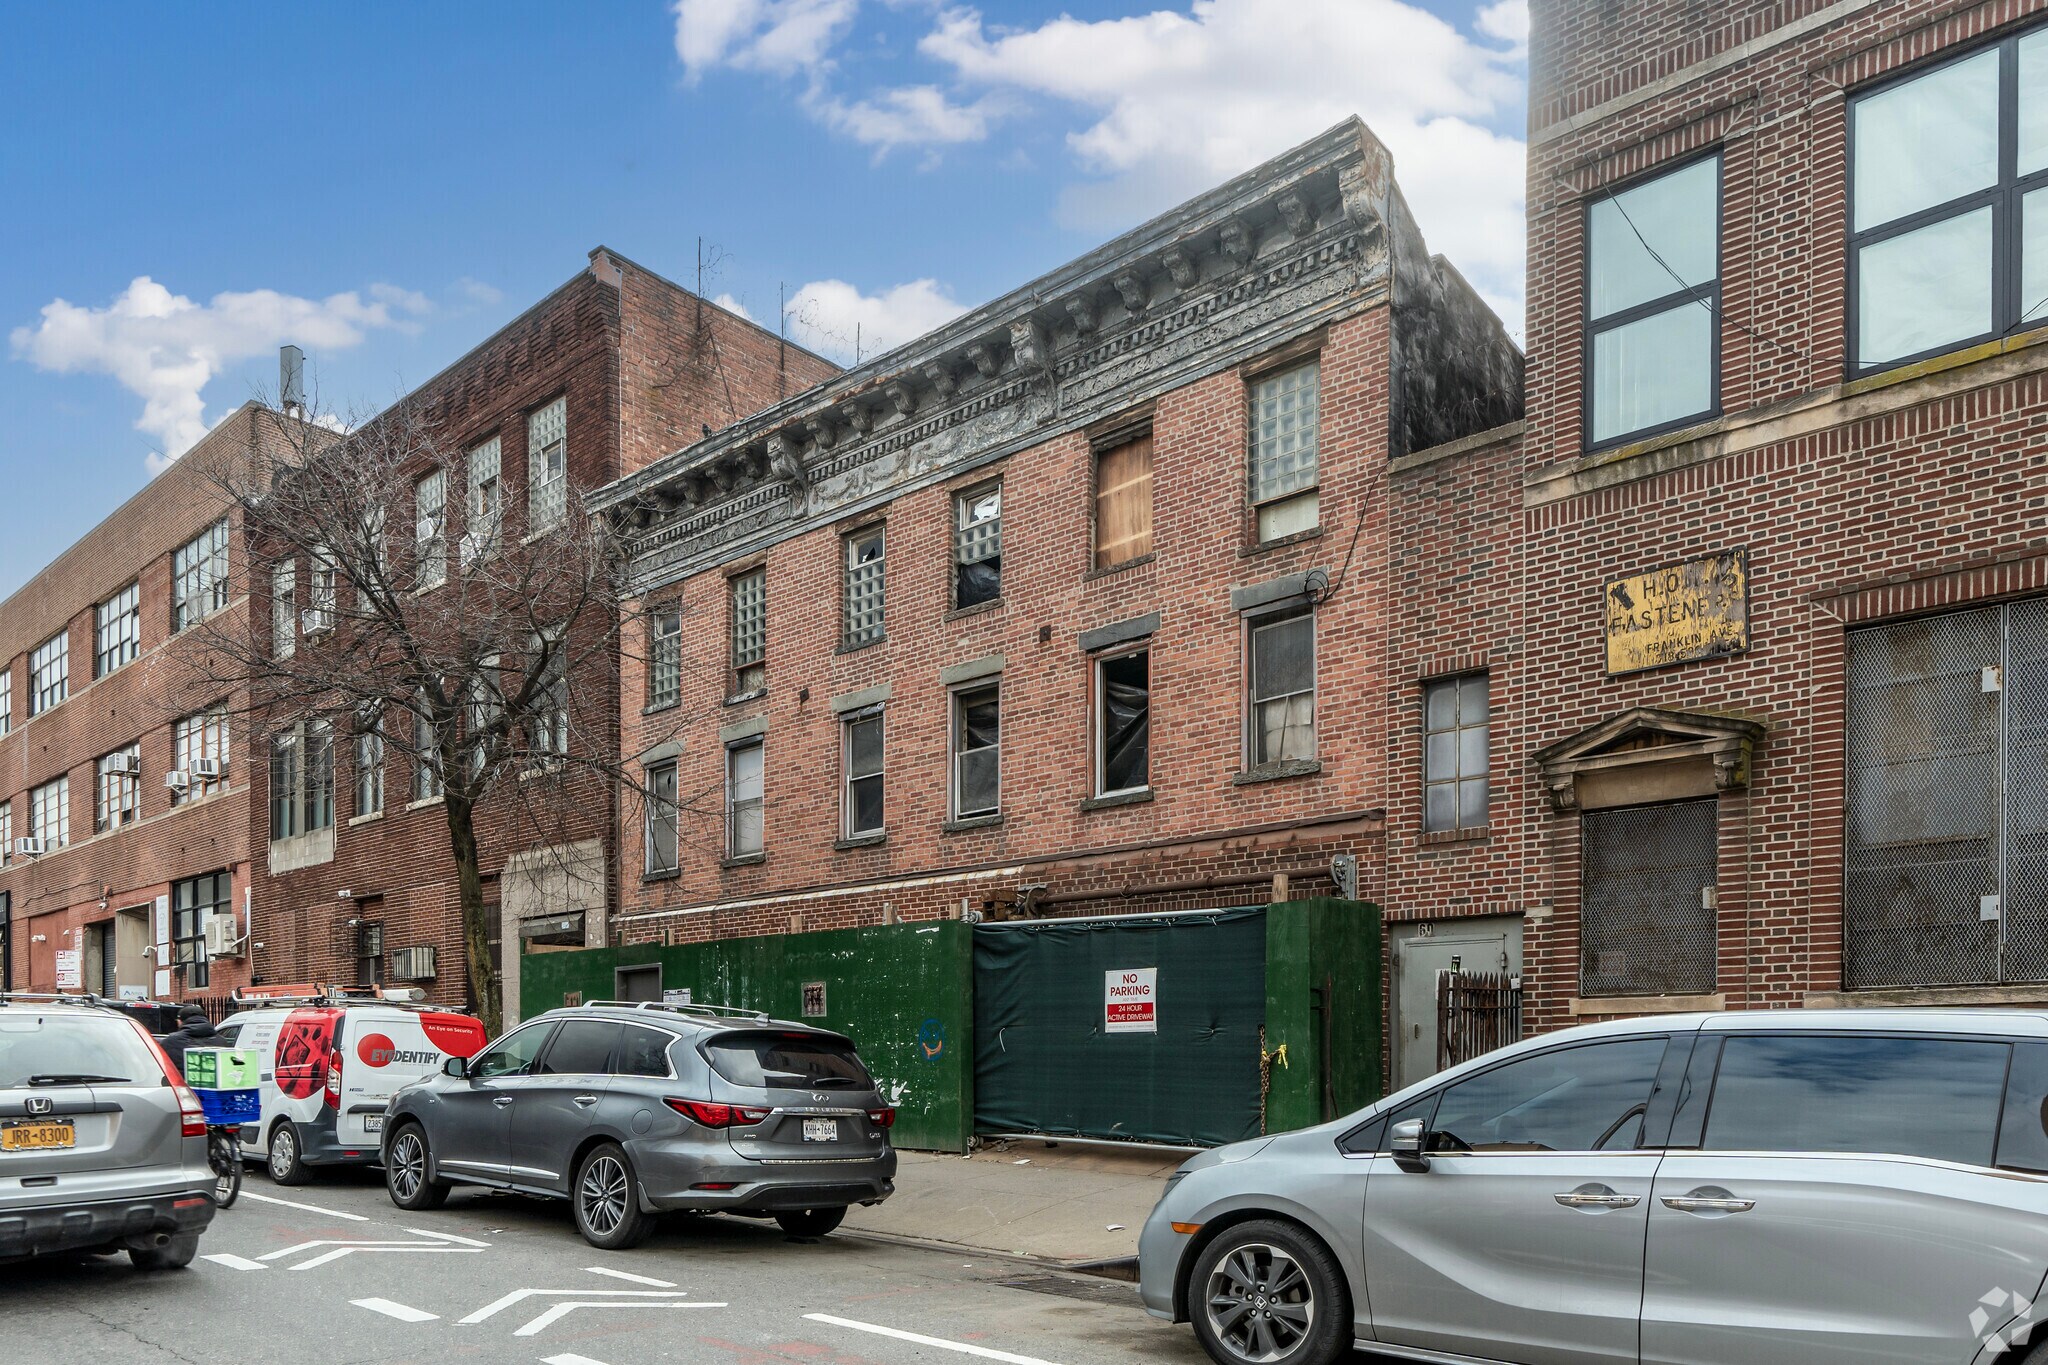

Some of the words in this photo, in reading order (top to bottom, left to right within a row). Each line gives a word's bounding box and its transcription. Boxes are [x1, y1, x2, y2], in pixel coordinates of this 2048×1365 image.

[1647, 632, 1702, 654] FRANKLIN
[1419, 923, 1434, 937] 60
[1122, 973, 1138, 984] NO
[1110, 985, 1150, 997] PARKING
